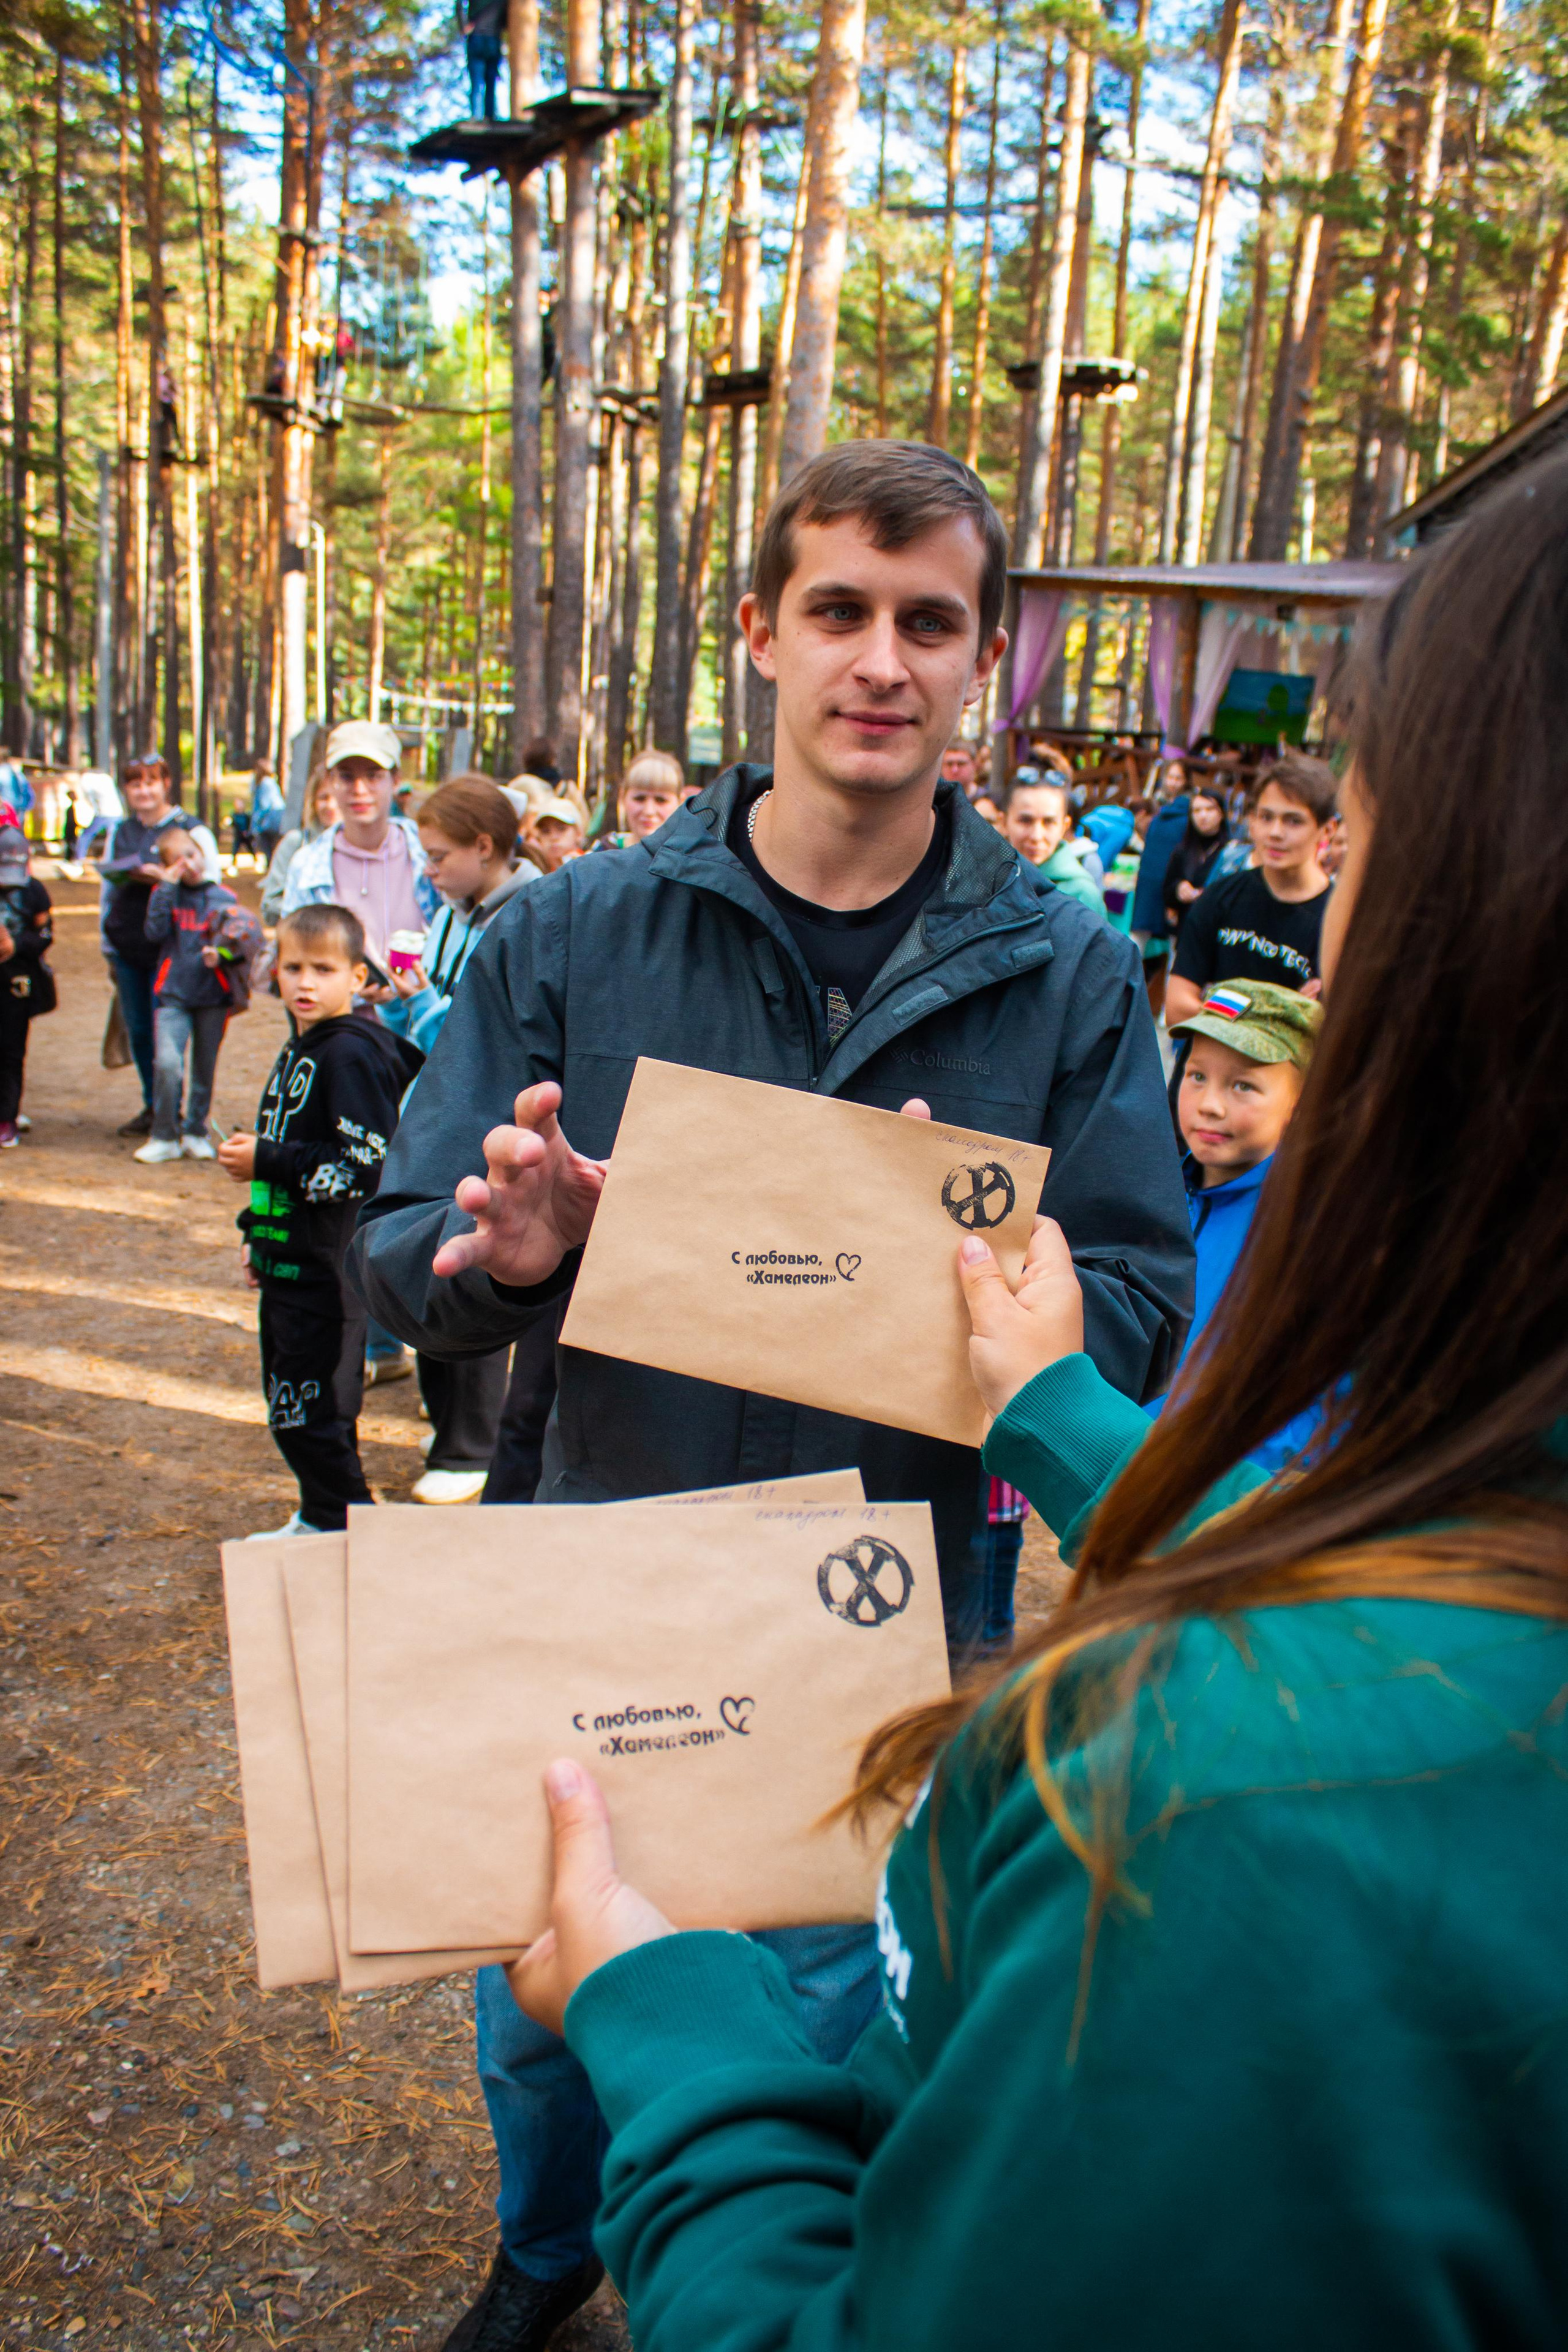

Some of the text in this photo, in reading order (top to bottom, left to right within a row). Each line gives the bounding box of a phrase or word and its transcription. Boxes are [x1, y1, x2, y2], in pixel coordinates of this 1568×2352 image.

[910, 1049, 992, 1076] Columbia
[731, 1250, 823, 1266] С любовью,
[747, 1270, 836, 1286] «Хамелеон»
[573, 1704, 702, 1732] С любовью,
[599, 1730, 725, 1756] «Хамелеон»
